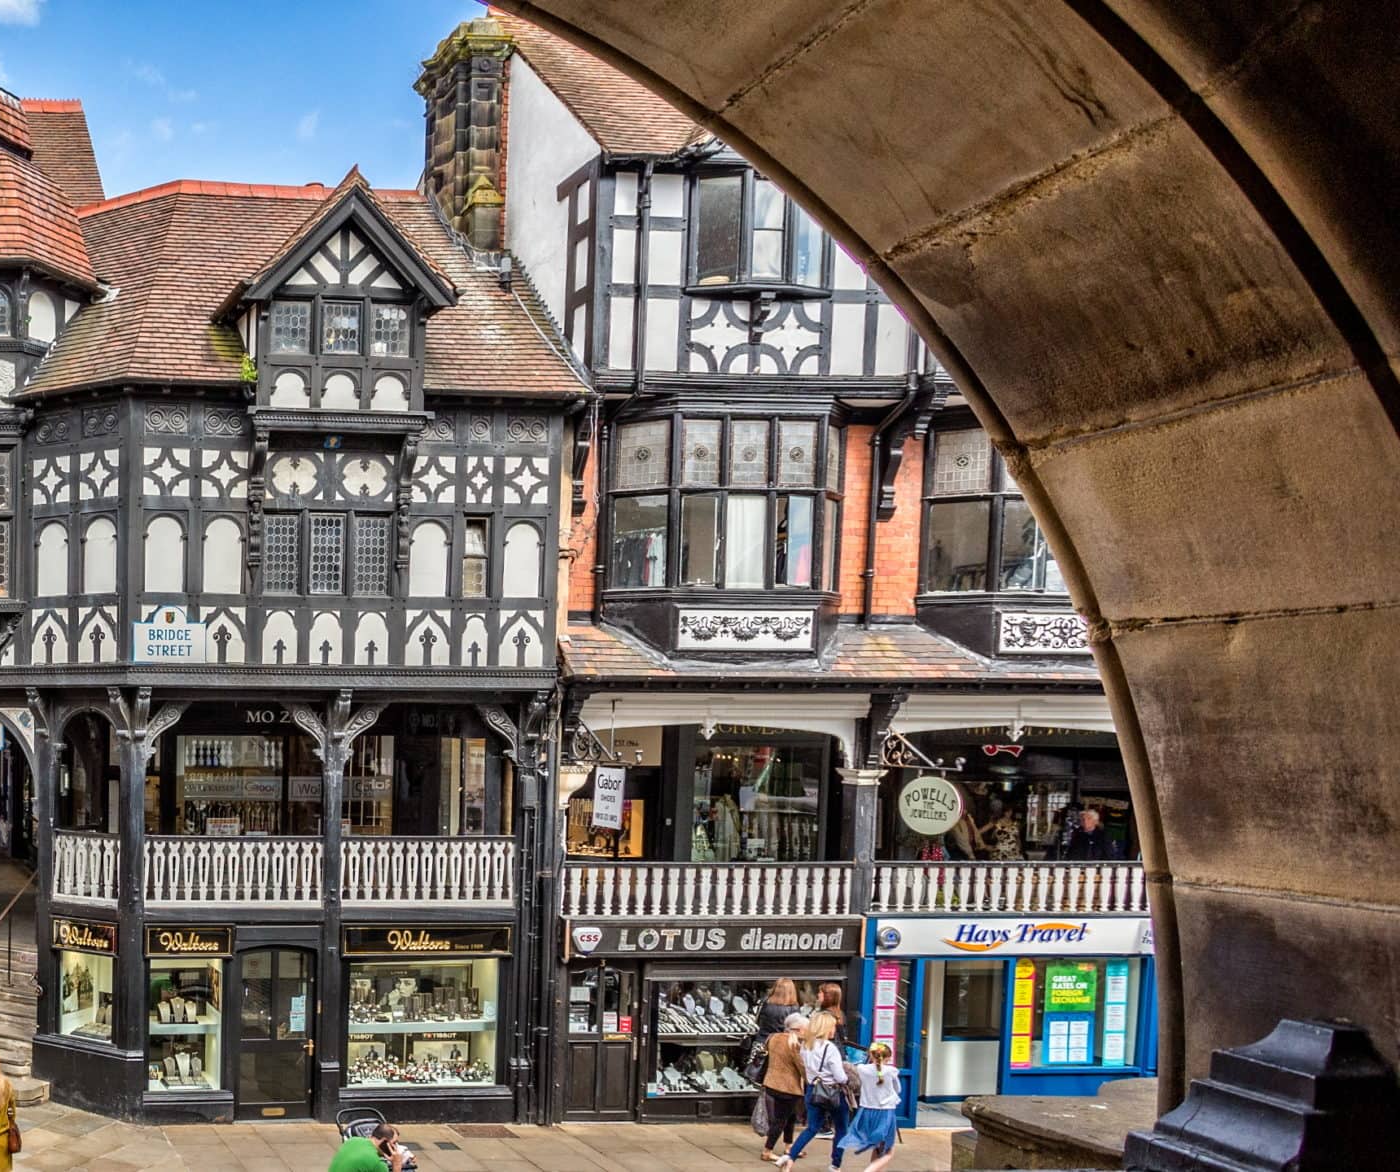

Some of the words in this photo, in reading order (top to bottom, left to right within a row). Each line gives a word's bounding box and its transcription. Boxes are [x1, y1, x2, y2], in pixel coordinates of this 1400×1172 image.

[149, 629, 192, 641] BRIDGE
[147, 645, 192, 657] STREET
[246, 710, 275, 723] MO
[598, 774, 621, 791] Gabor
[905, 788, 956, 811] POWELLS
[923, 801, 935, 810] THE
[910, 809, 947, 821] JEWELLERS
[60, 921, 109, 950] Waltons
[160, 931, 219, 951] Waltons
[387, 930, 451, 951] Waltons
[580, 934, 599, 943] CSS
[618, 928, 726, 951] LOTUS
[740, 927, 844, 951] diamond
[954, 924, 1011, 947] Hays
[1015, 922, 1088, 943] Travel
